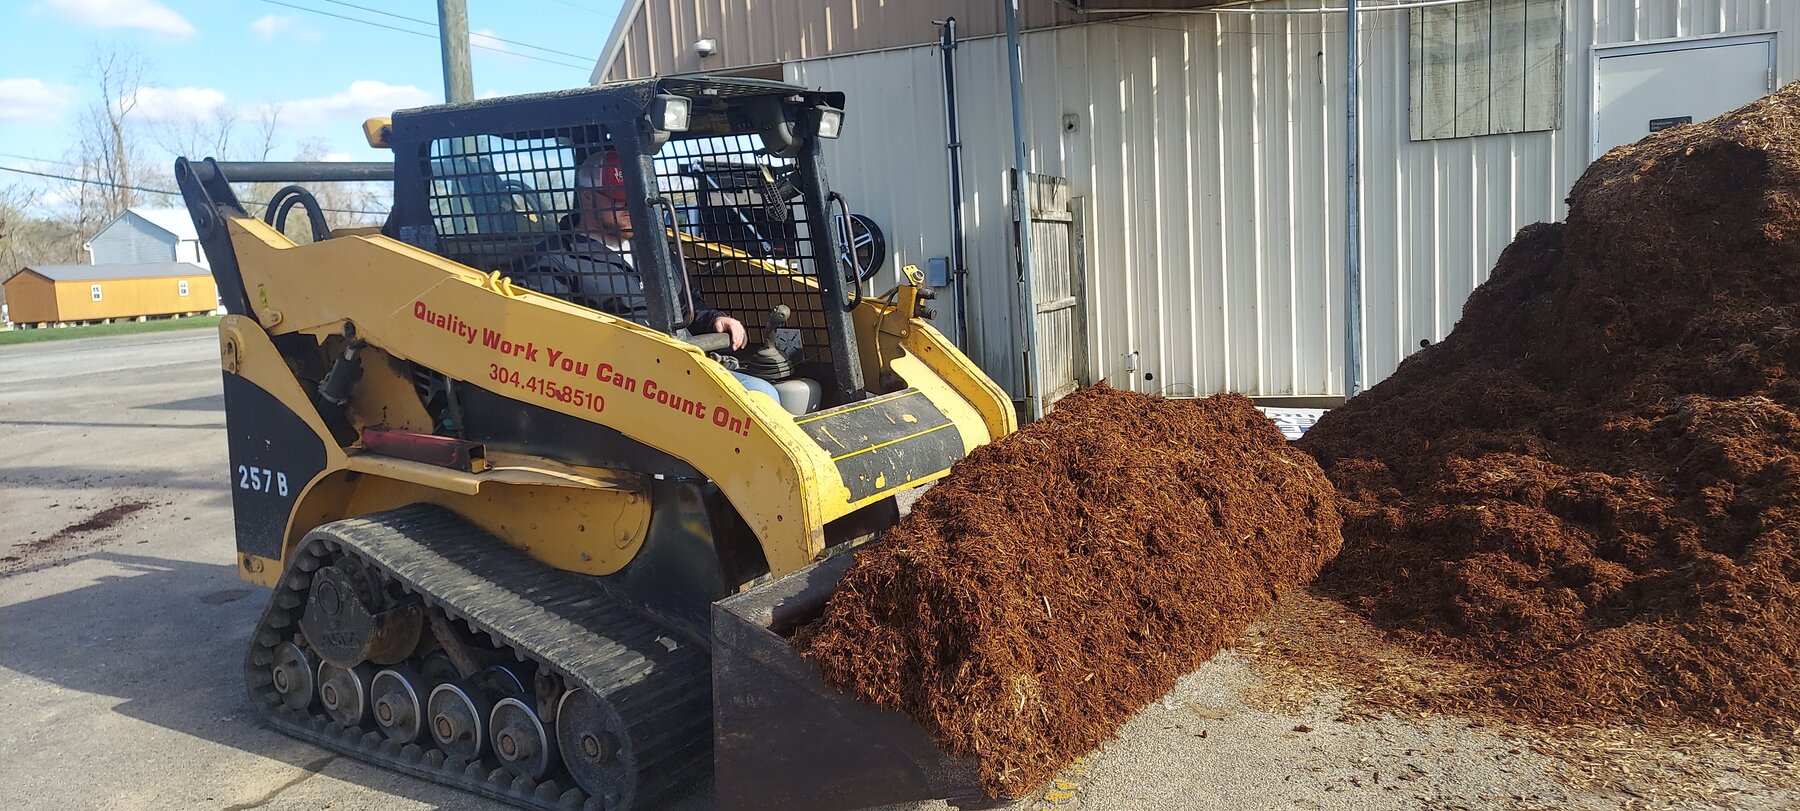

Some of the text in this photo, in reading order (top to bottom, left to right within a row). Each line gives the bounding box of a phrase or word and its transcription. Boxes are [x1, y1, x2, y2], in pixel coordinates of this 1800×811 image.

[413, 301, 752, 437] Quality Work You Can Count On!
[239, 464, 288, 497] 257 B
